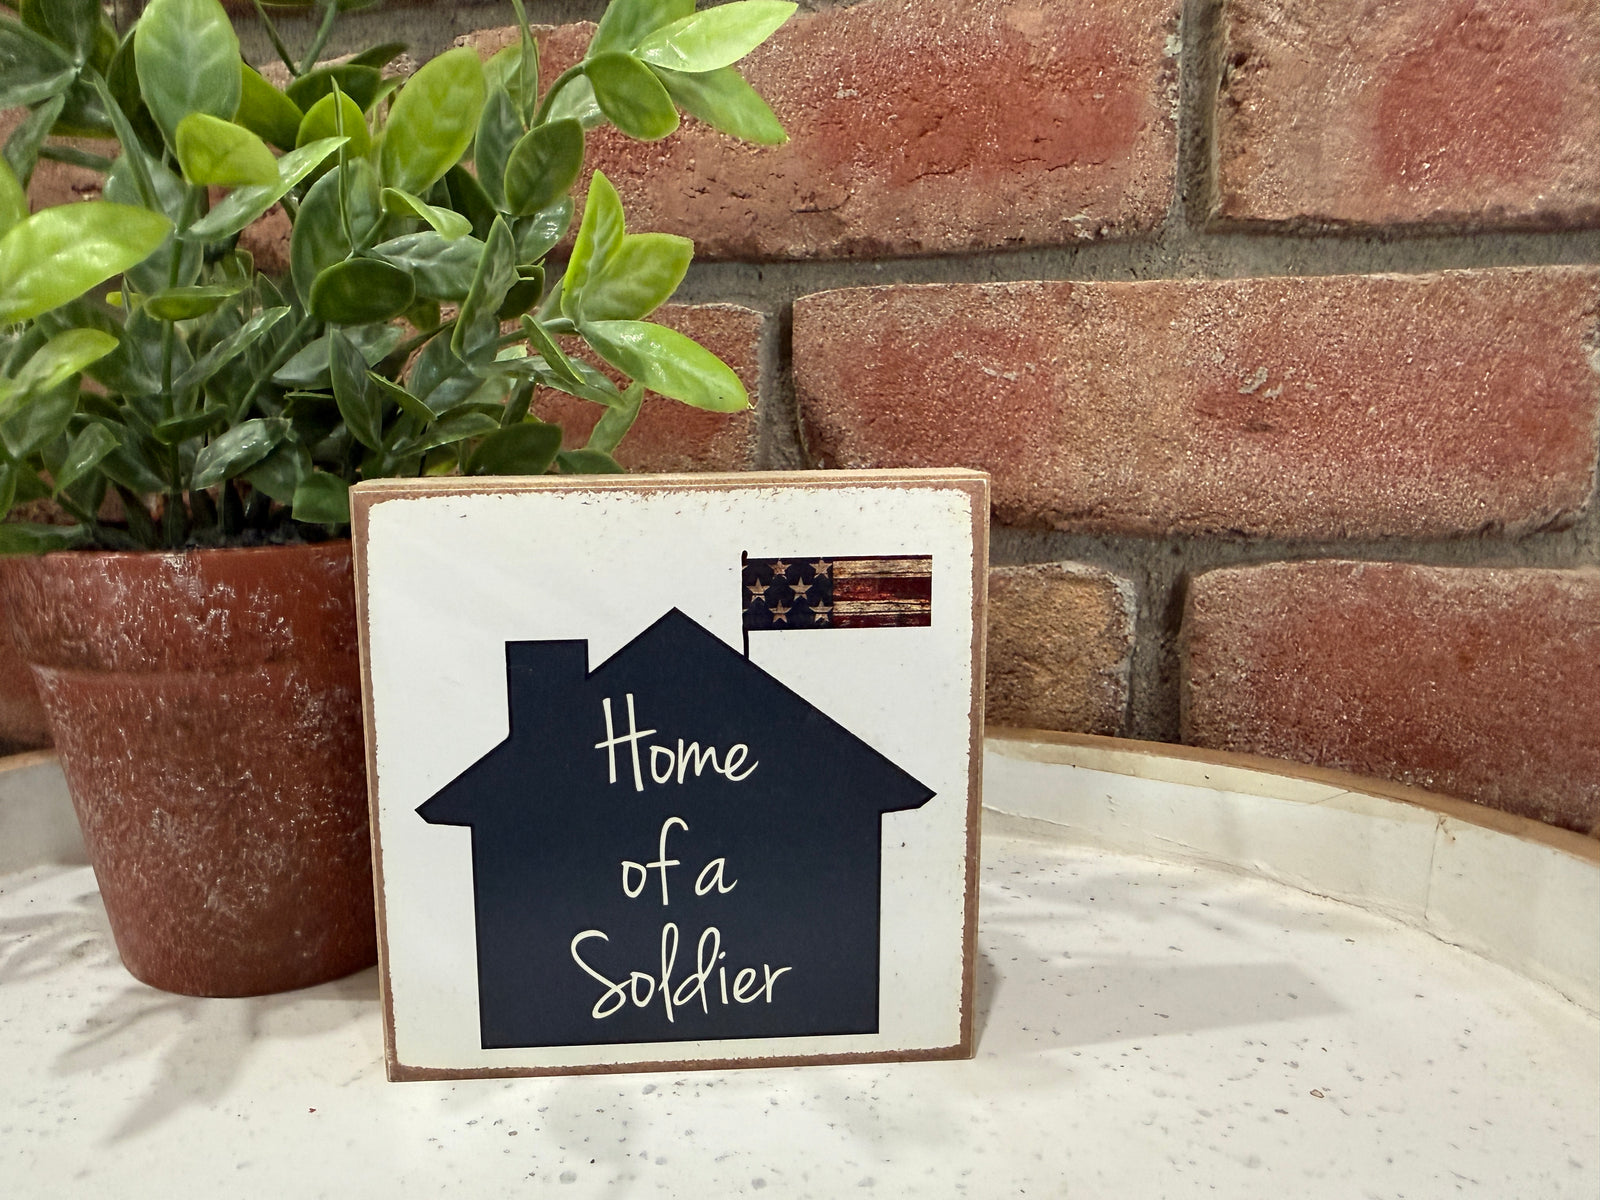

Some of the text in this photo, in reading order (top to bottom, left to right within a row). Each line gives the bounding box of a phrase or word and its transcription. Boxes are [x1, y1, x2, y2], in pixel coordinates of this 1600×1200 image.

[594, 693, 759, 792] Home
[620, 816, 738, 906] of a
[570, 922, 793, 1023] Soldier
